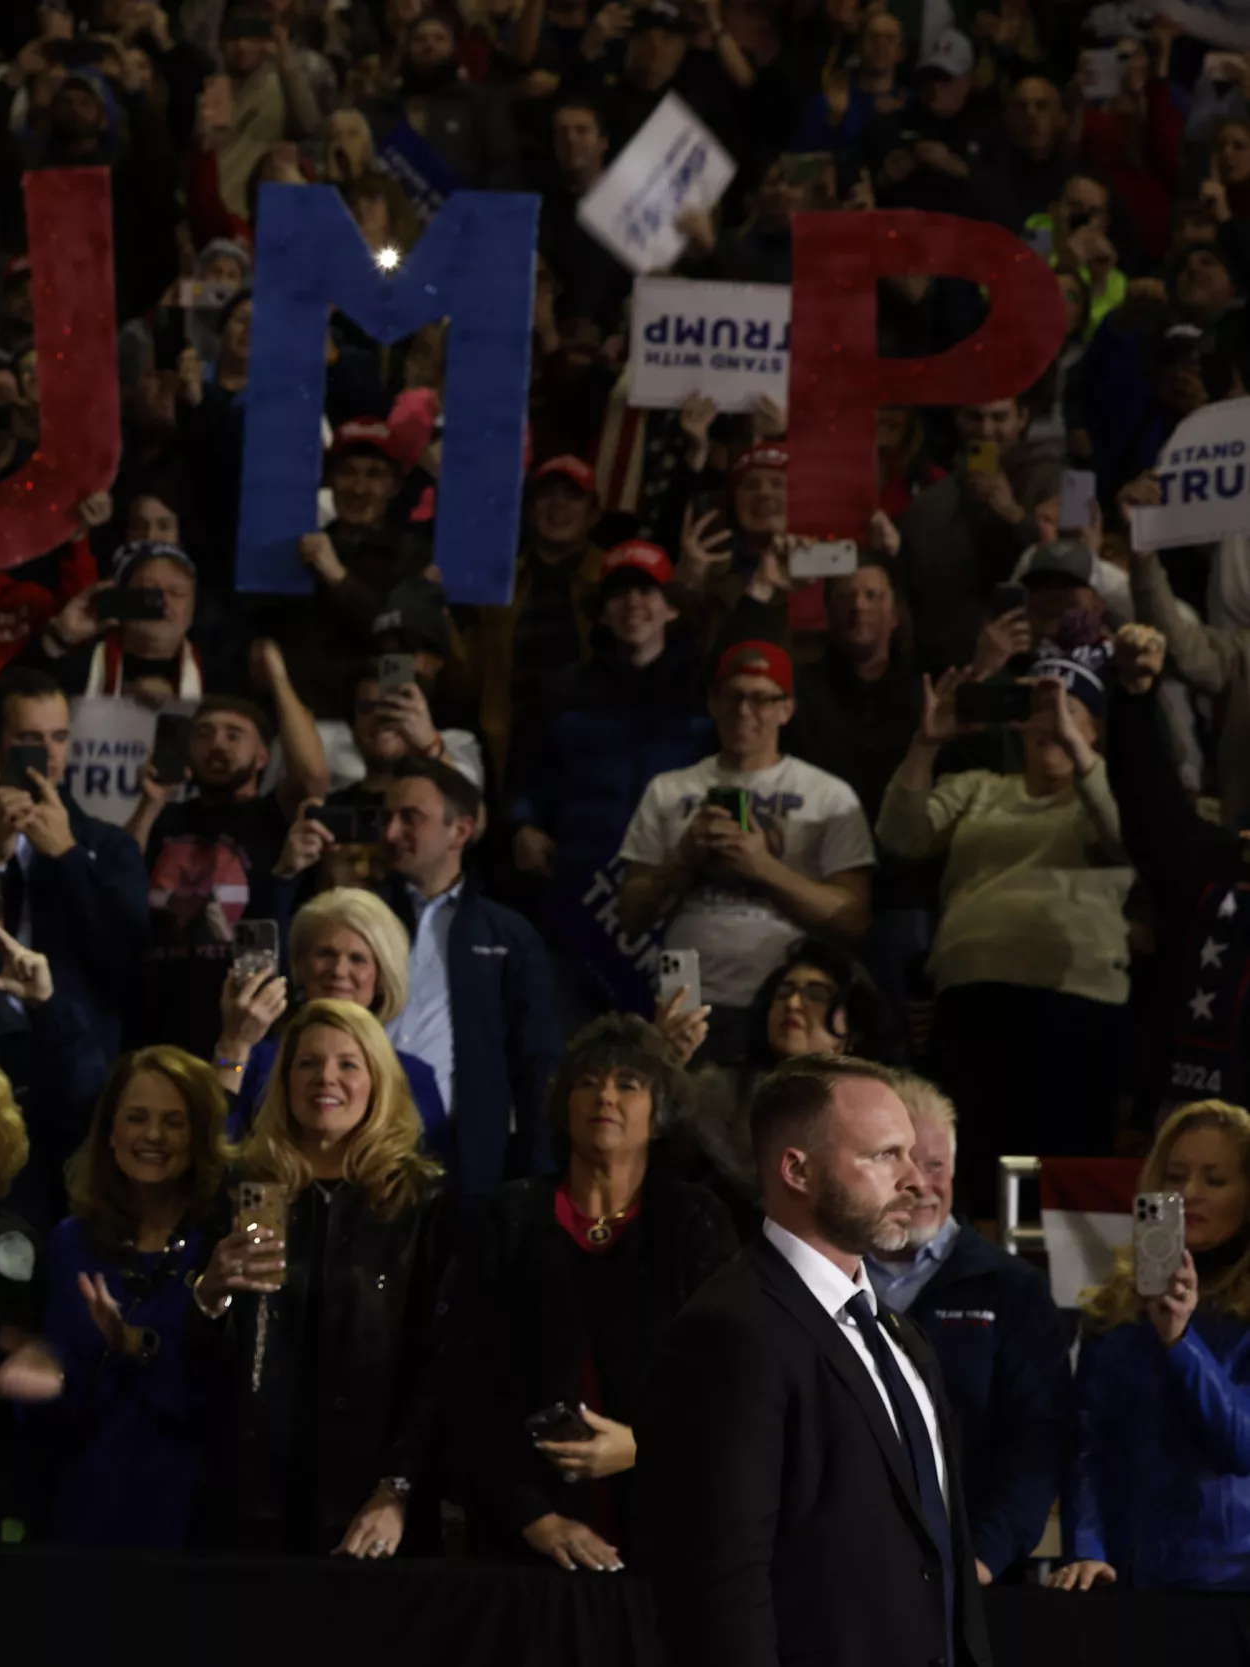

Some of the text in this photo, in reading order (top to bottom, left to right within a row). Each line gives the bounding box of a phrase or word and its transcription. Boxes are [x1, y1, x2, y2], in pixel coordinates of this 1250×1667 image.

[1171, 441, 1245, 466] STAND
[1160, 463, 1250, 507] TRU
[72, 739, 147, 758] STAND
[65, 764, 141, 797] TRU
[1171, 1061, 1222, 1093] 2024
